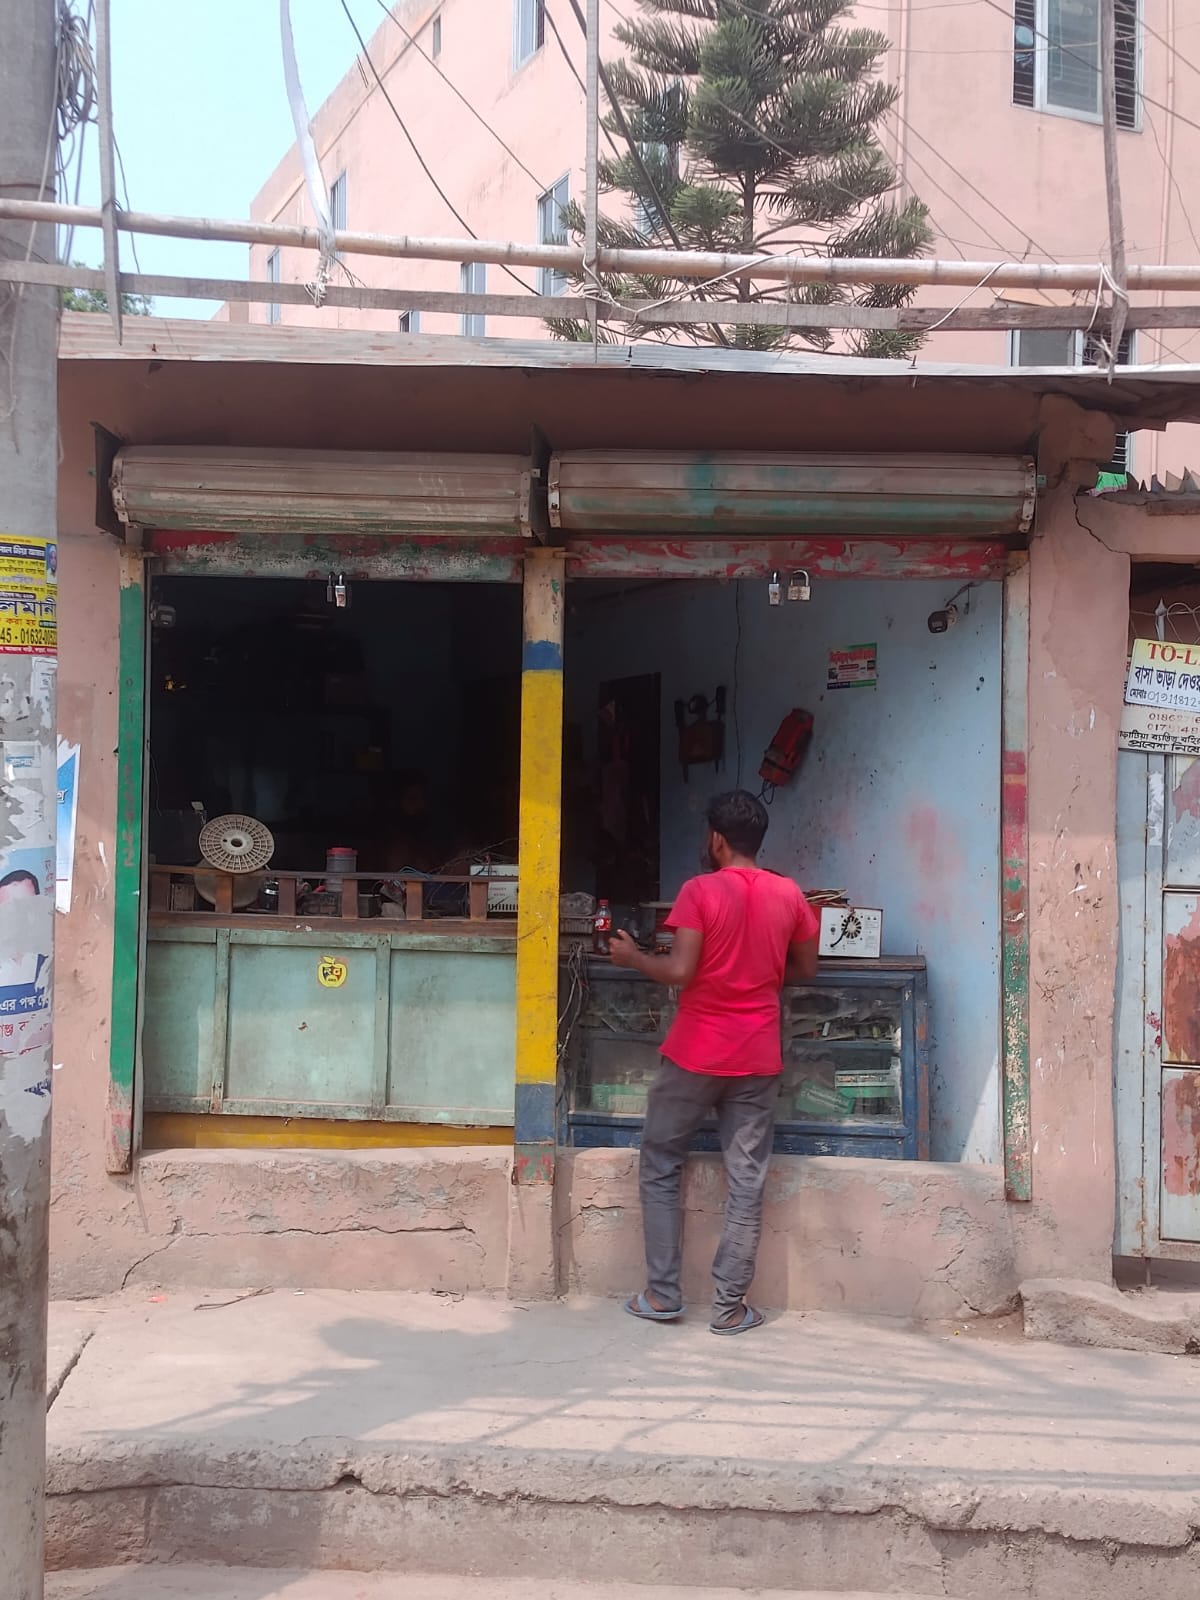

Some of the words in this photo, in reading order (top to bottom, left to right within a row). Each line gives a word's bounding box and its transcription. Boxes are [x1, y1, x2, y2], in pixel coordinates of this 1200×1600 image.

[1134, 665, 1154, 686] বাসা
[1156, 668, 1177, 691] ভাড়া
[1127, 739, 1170, 752] প্রবেশ
